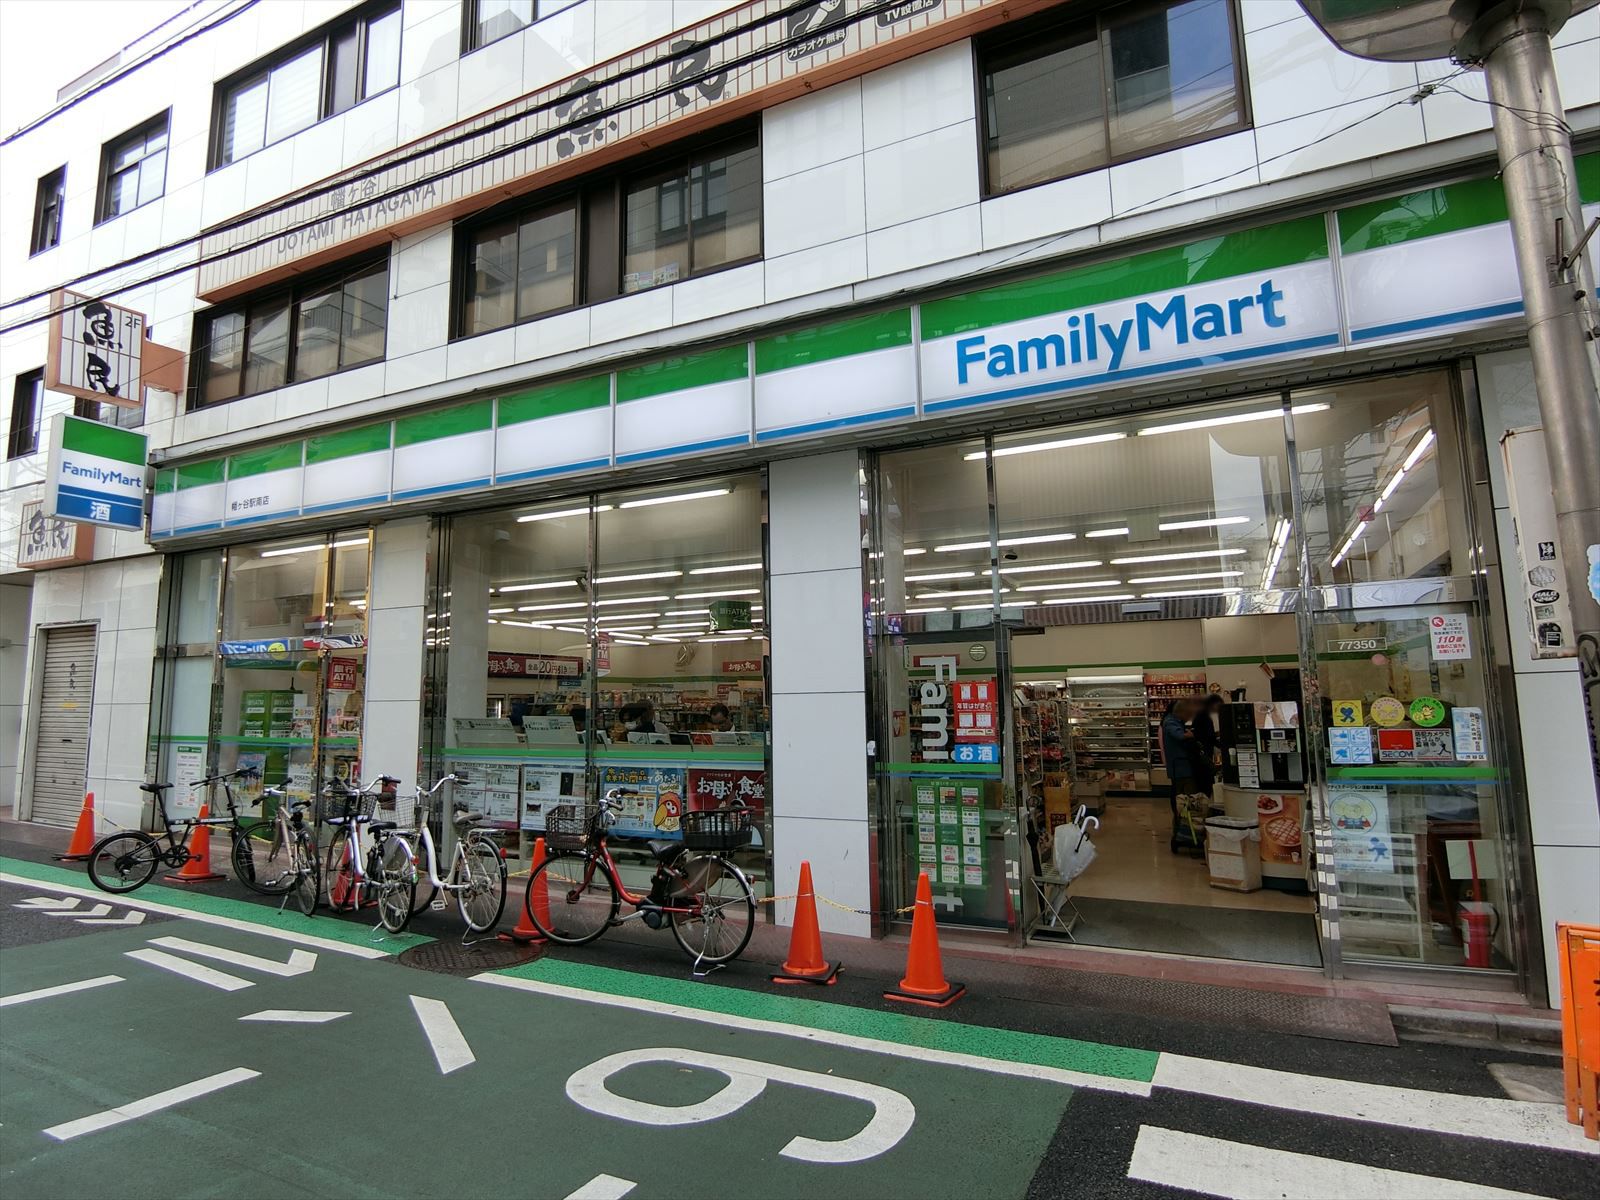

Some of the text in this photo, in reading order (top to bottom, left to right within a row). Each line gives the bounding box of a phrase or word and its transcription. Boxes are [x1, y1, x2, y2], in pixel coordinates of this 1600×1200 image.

[788, 28, 846, 58] カラオケ無料
[278, 183, 437, 254] UOTAMI HATAGAYA
[124, 315, 142, 329] 2F
[957, 280, 1286, 385] FamilyMart
[62, 461, 142, 488] FamilyMart
[90, 501, 112, 521] 酒
[1337, 640, 1377, 650] 77350
[333, 673, 354, 681] ATM
[960, 745, 993, 761] お酒
[1382, 750, 1413, 758] SECOM
